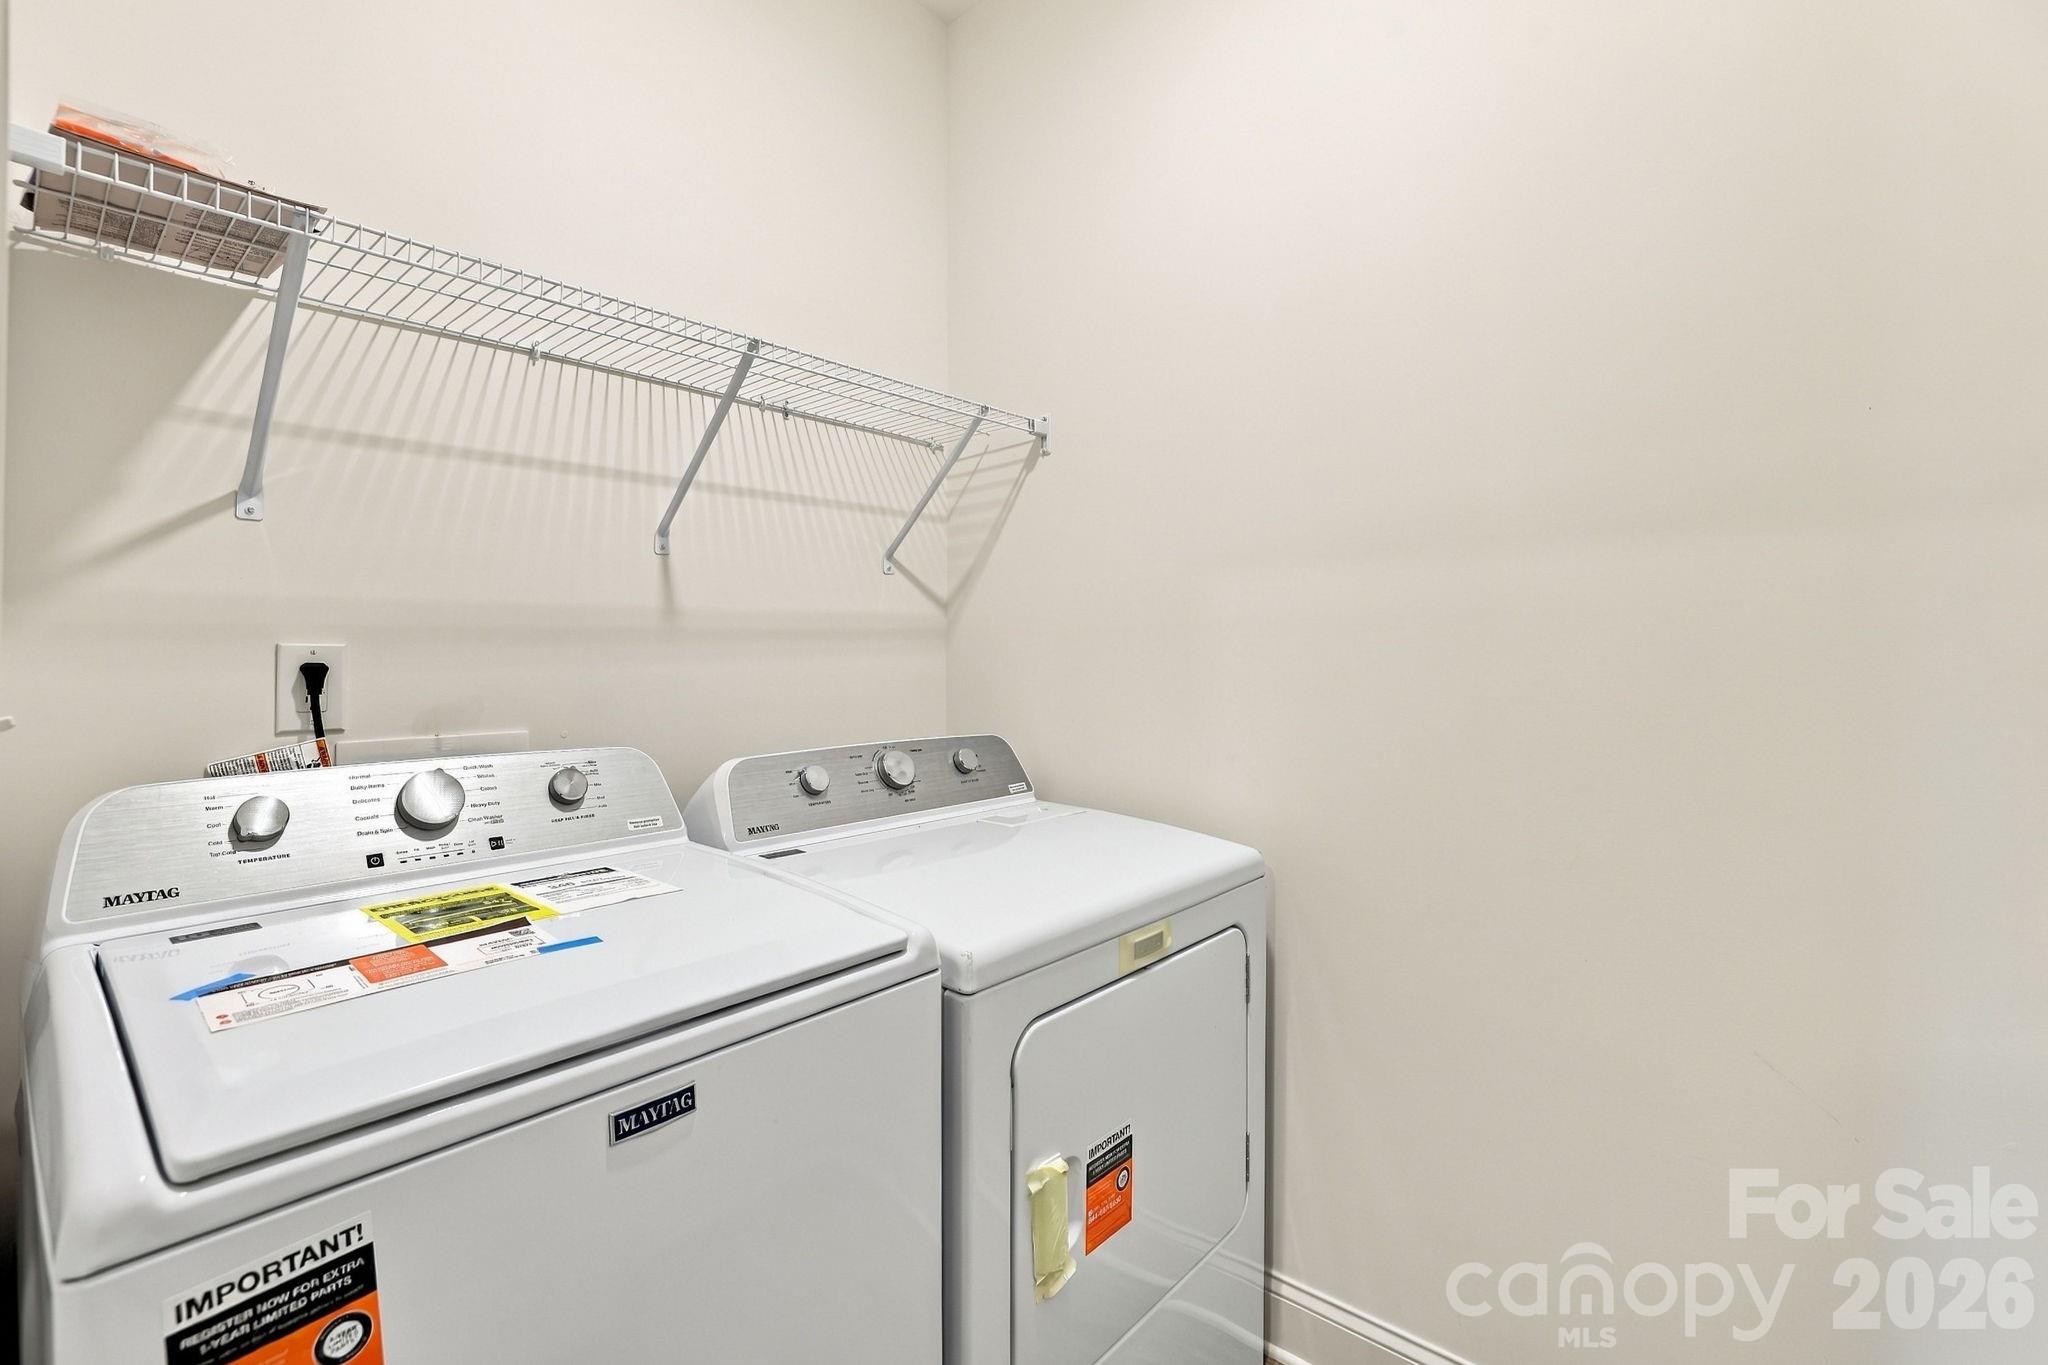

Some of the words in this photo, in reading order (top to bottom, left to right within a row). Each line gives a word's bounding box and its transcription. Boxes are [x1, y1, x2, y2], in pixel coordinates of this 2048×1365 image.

[747, 823, 779, 835] MAYTAG
[238, 853, 290, 864] TEMPERATURE
[102, 887, 180, 908] MAYTAG
[618, 1091, 692, 1135] MAYTAG
[1088, 1123, 1130, 1159] IMPORTANT!
[174, 1222, 364, 1324] IMPORTANT!
[179, 1308, 253, 1350] REGISTER
[256, 1291, 290, 1315] NOW
[292, 1277, 320, 1298] FOR
[323, 1257, 365, 1283] EXTRA
[253, 1296, 308, 1330] LIMITED
[311, 1275, 352, 1301] PARTS
